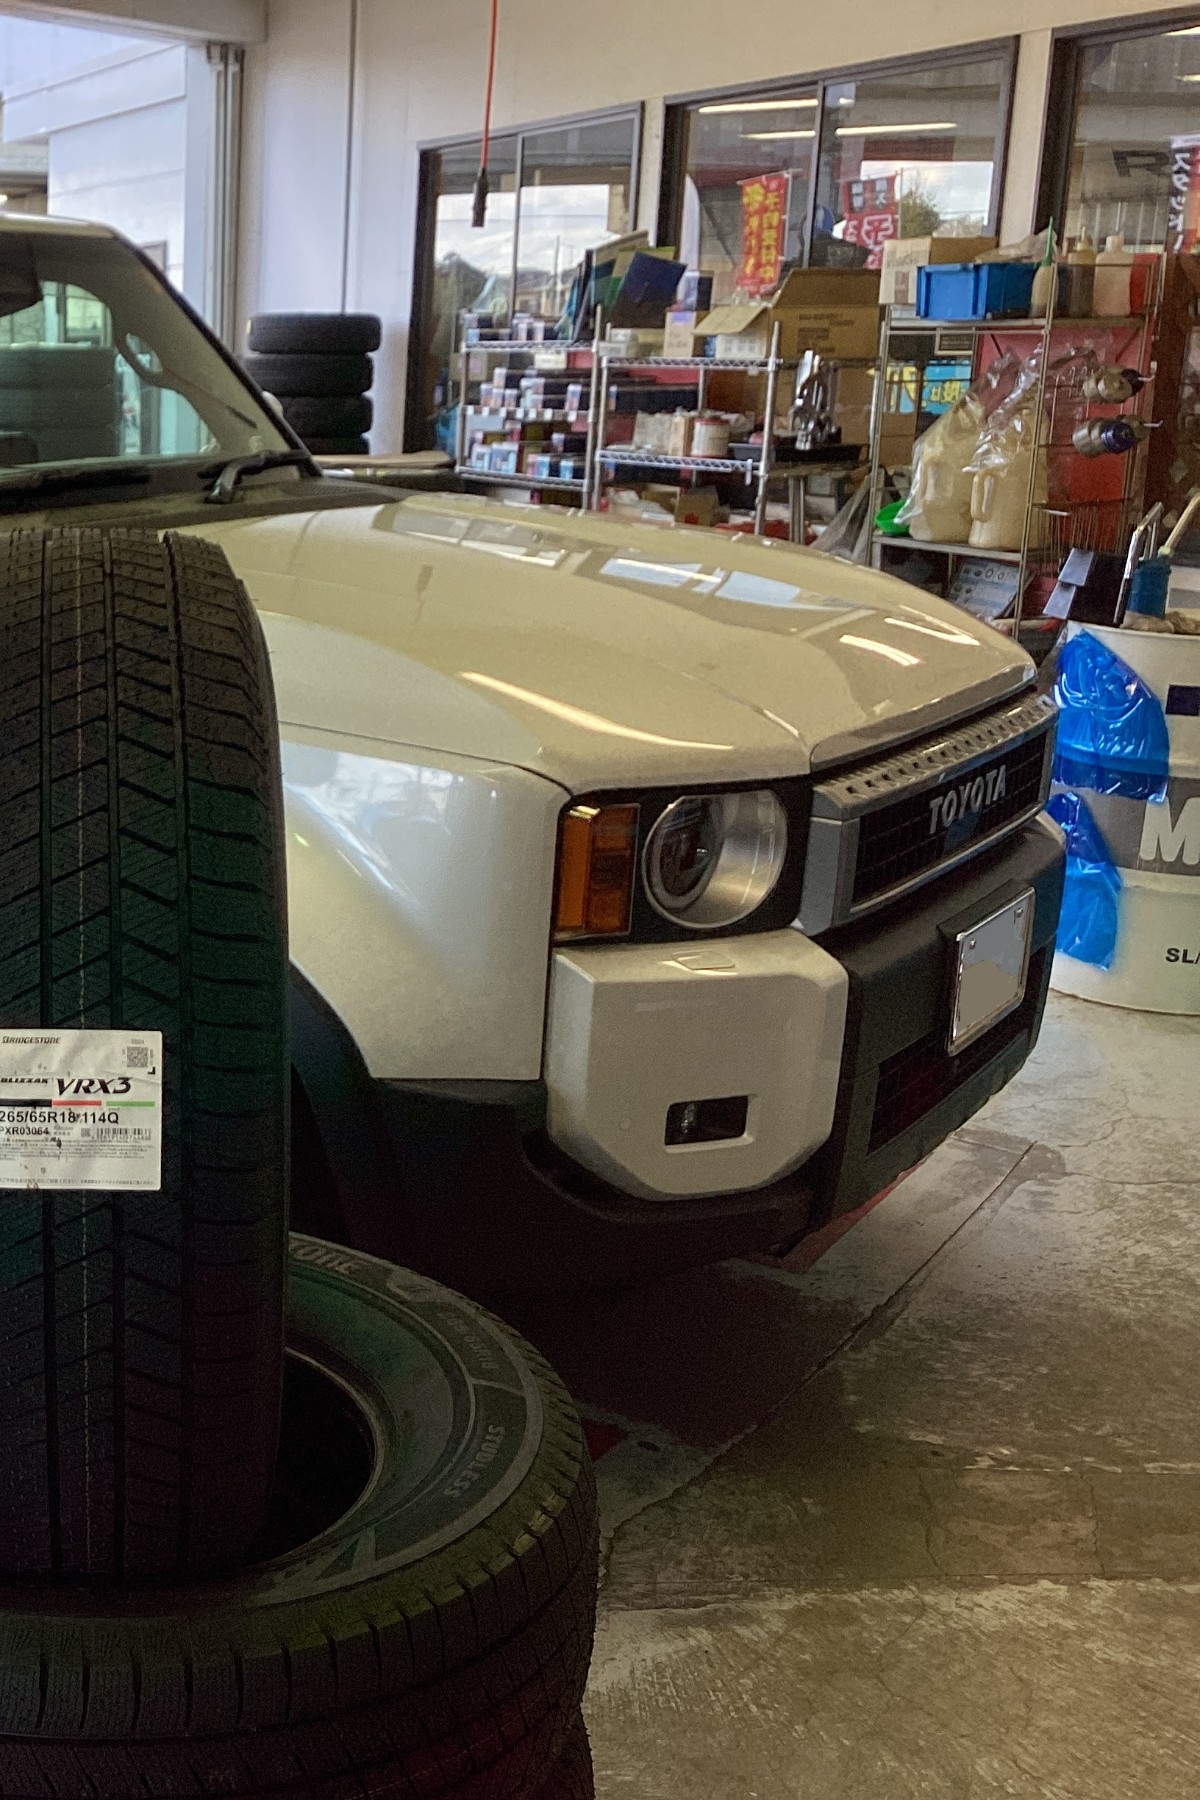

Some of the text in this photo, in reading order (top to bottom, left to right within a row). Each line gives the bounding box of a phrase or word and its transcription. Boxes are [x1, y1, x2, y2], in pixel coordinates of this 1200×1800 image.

[929, 765, 1007, 835] TOYOTA
[2, 1036, 62, 1045] BRIDGESTONE
[0, 1077, 133, 1096] BLIZZAK VRX3
[82, 1111, 119, 1125] 114Q
[442, 1423, 506, 1498] STUDLESS
